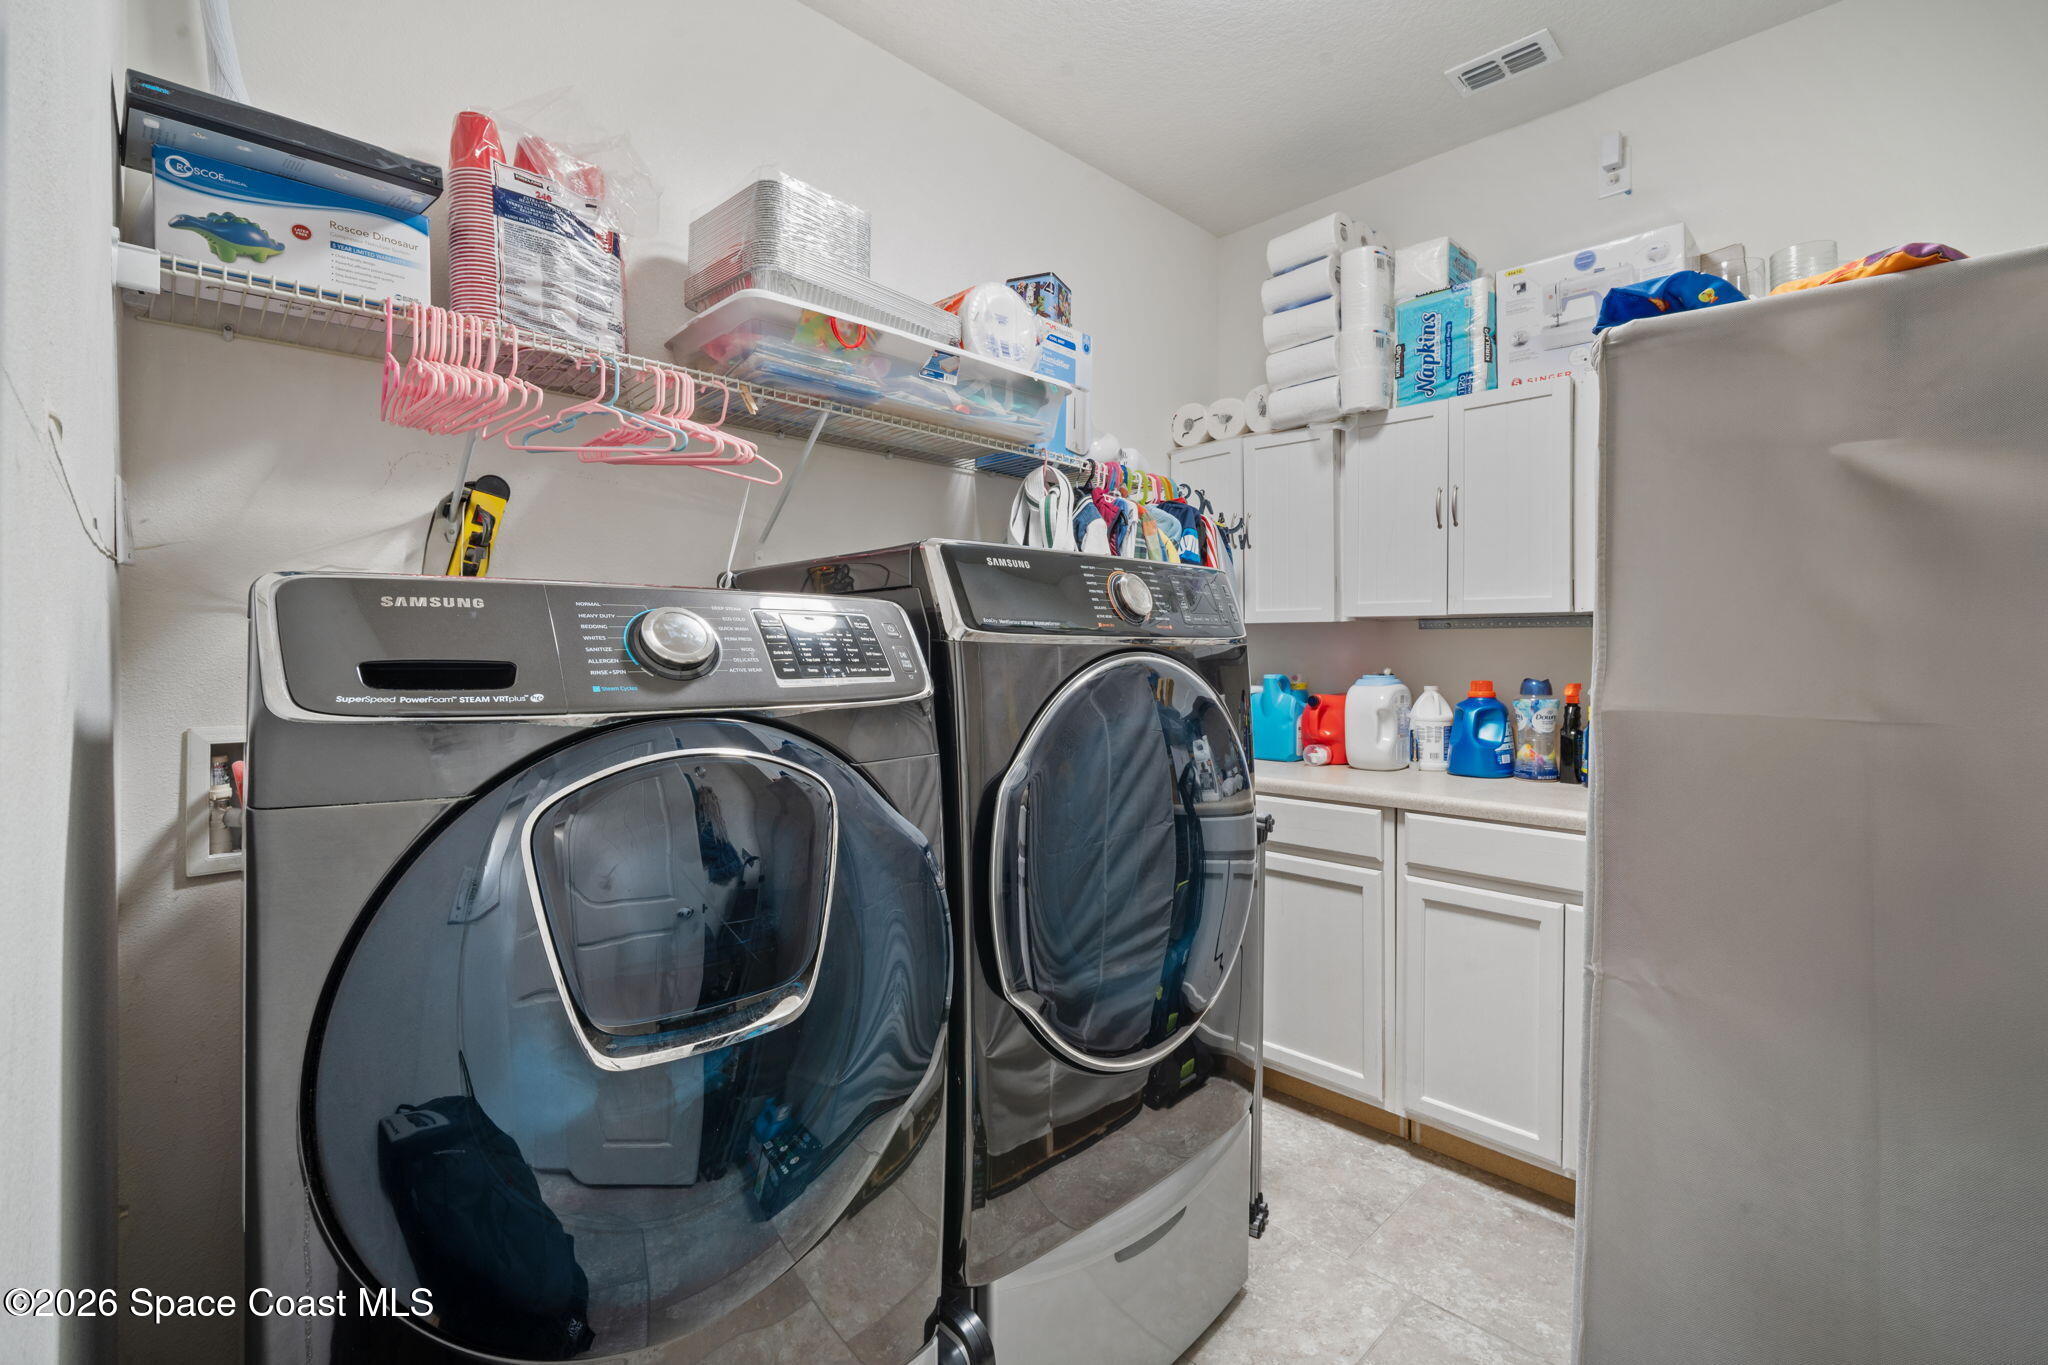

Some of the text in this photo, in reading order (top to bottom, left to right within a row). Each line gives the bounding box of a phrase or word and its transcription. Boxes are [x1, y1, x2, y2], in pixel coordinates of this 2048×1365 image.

[175, 162, 225, 182] ROSCOE
[329, 220, 419, 251] Roscoe Dinosaur
[1414, 312, 1441, 397] Napkins
[986, 557, 1031, 569] SAMSUNG
[380, 596, 485, 609] SAMSUNG
[335, 695, 396, 704] SuperSpeed
